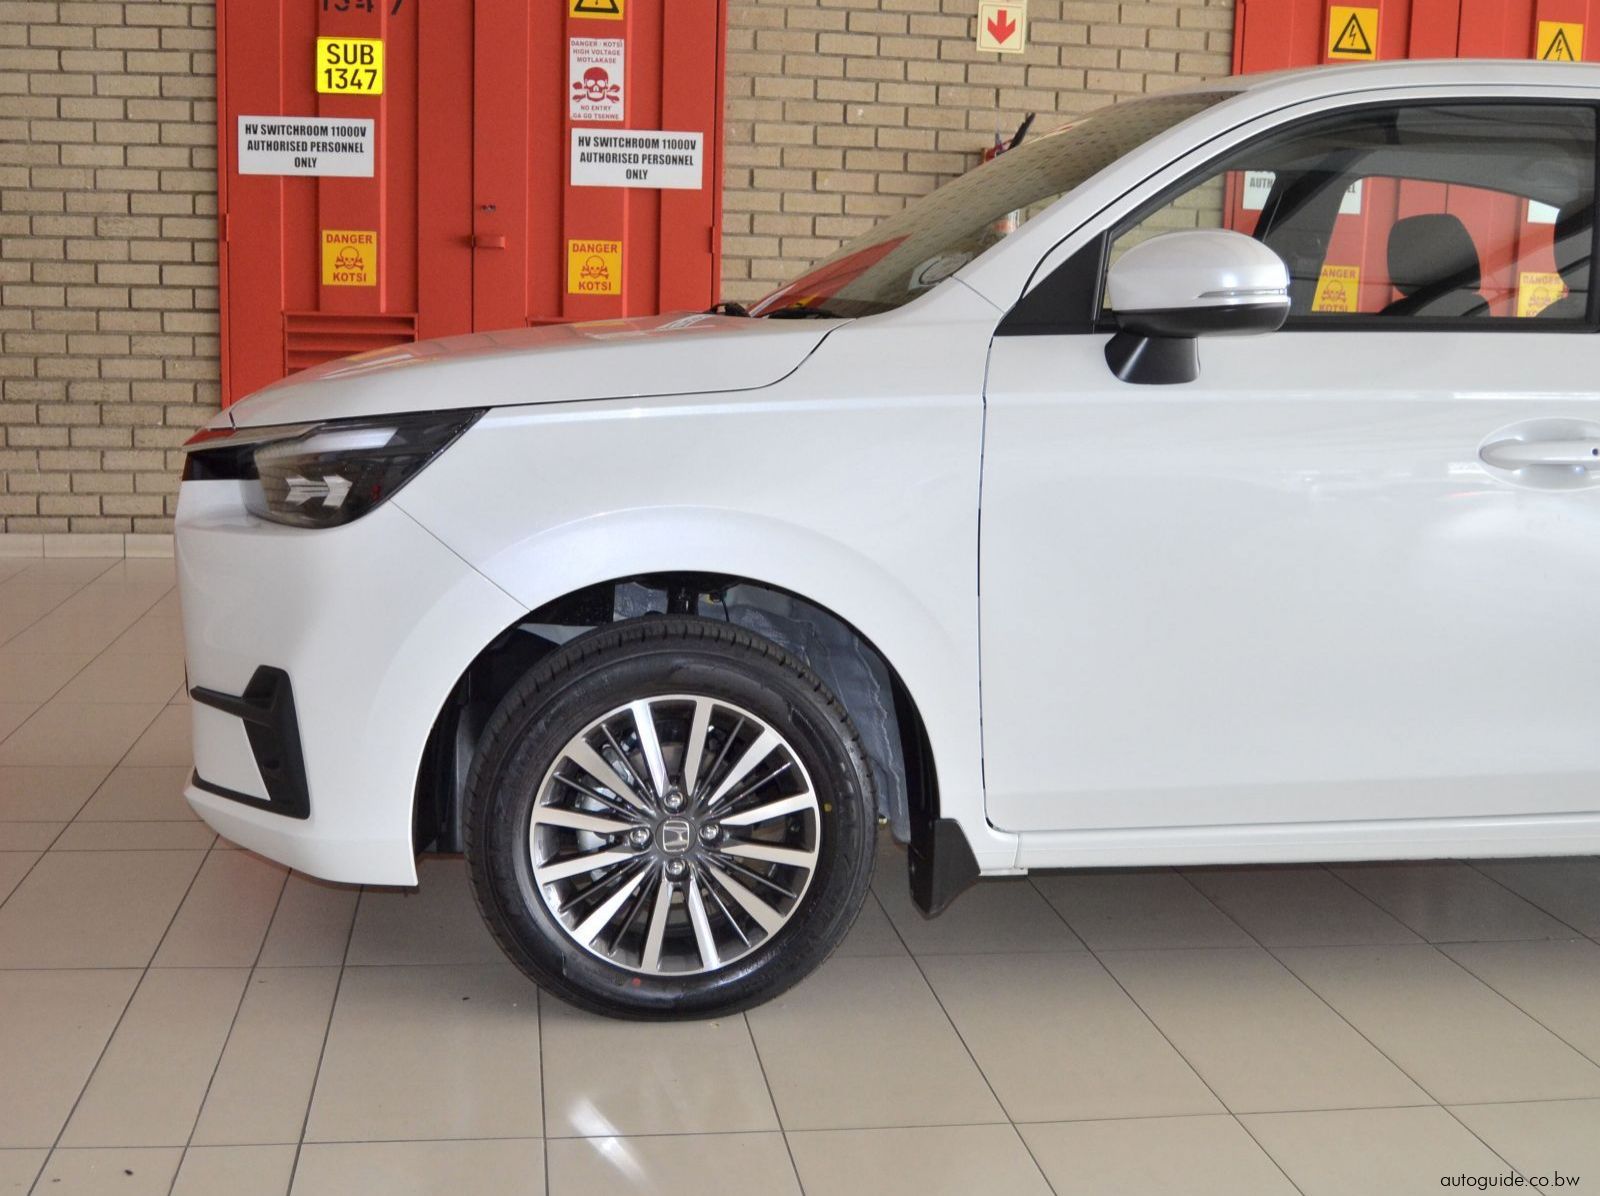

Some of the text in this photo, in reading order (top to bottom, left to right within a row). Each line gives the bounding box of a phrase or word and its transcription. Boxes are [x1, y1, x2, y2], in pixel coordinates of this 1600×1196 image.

[571, 40, 598, 48] DANGER
[326, 43, 375, 65] SUB
[324, 68, 378, 90] 1347
[245, 123, 367, 138] HV SWITCHROOM 11000V
[247, 140, 364, 153] AUTHORISED PERSONNEL
[578, 136, 697, 150] HV SWITCHROOM 11000V
[294, 157, 318, 169] ONLY
[580, 152, 694, 166] AUTHORISED PERSONNEL
[625, 168, 649, 180] ONLY
[1249, 177, 1275, 188] AUTH
[326, 233, 373, 245] DANGER
[572, 243, 618, 254] DANGER
[333, 272, 367, 283] KOTSI
[1321, 269, 1357, 279] ANGER
[578, 281, 612, 292] KOTSI
